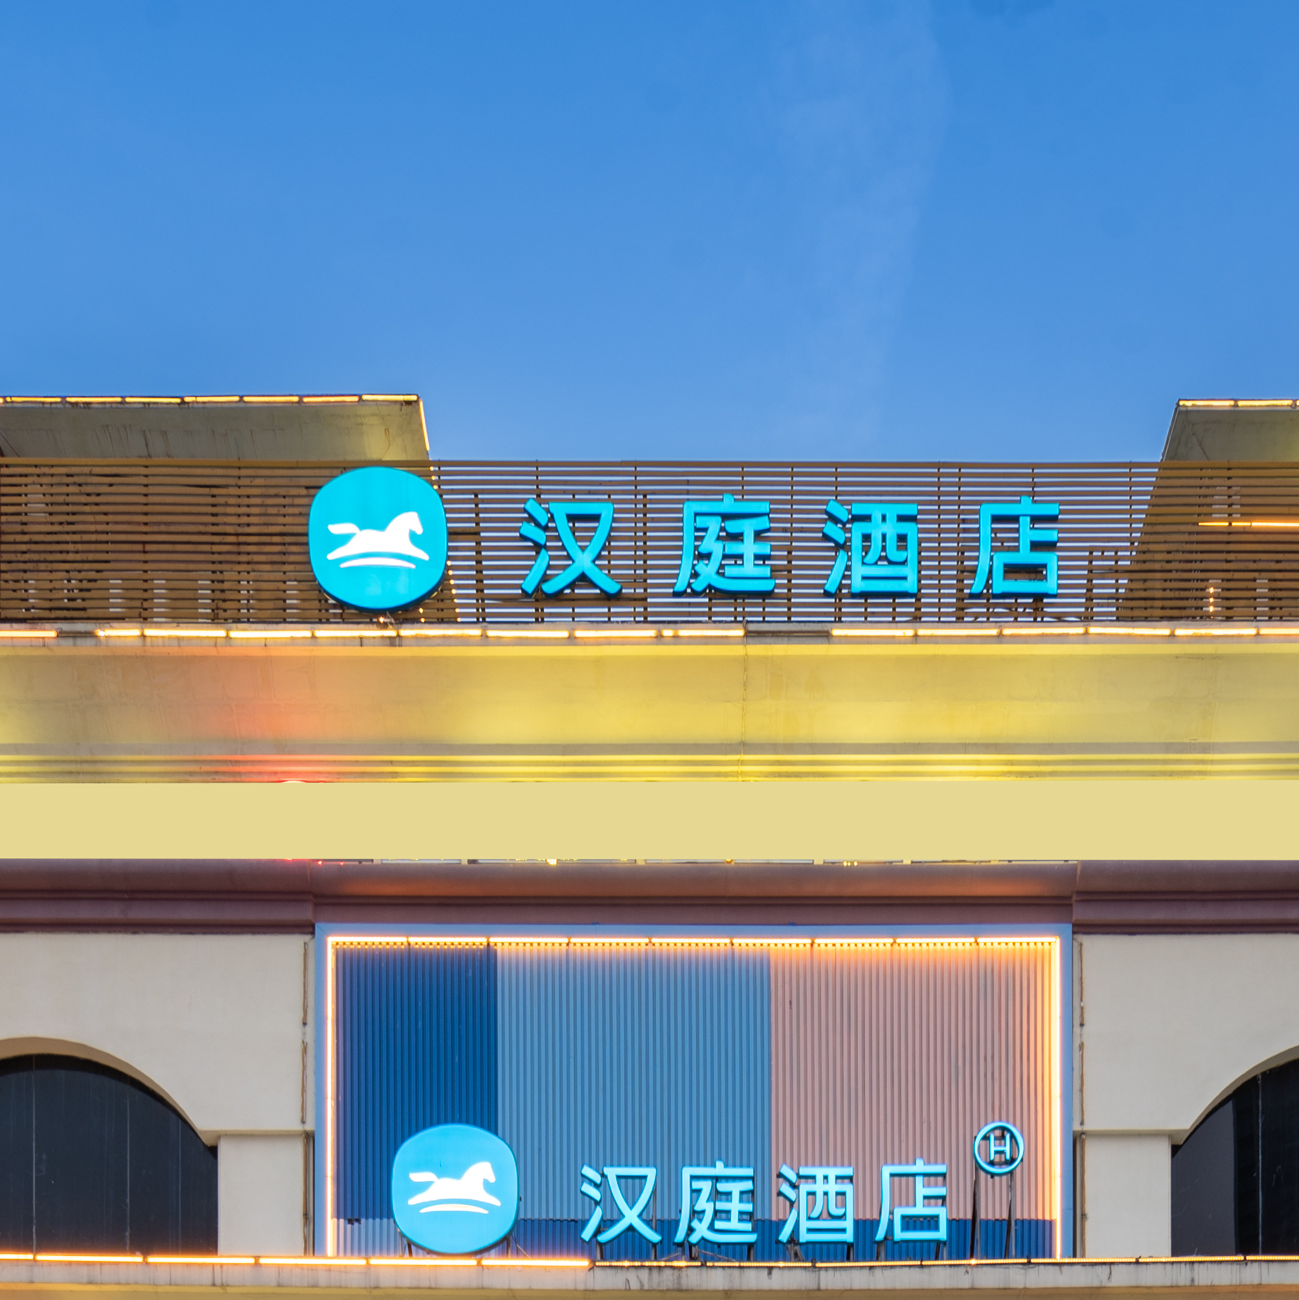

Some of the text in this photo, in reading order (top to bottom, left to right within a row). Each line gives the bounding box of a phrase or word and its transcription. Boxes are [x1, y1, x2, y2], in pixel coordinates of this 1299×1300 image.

[519, 493, 1060, 599] 汉庭酒店
[580, 1158, 948, 1245] 汉庭酒店
